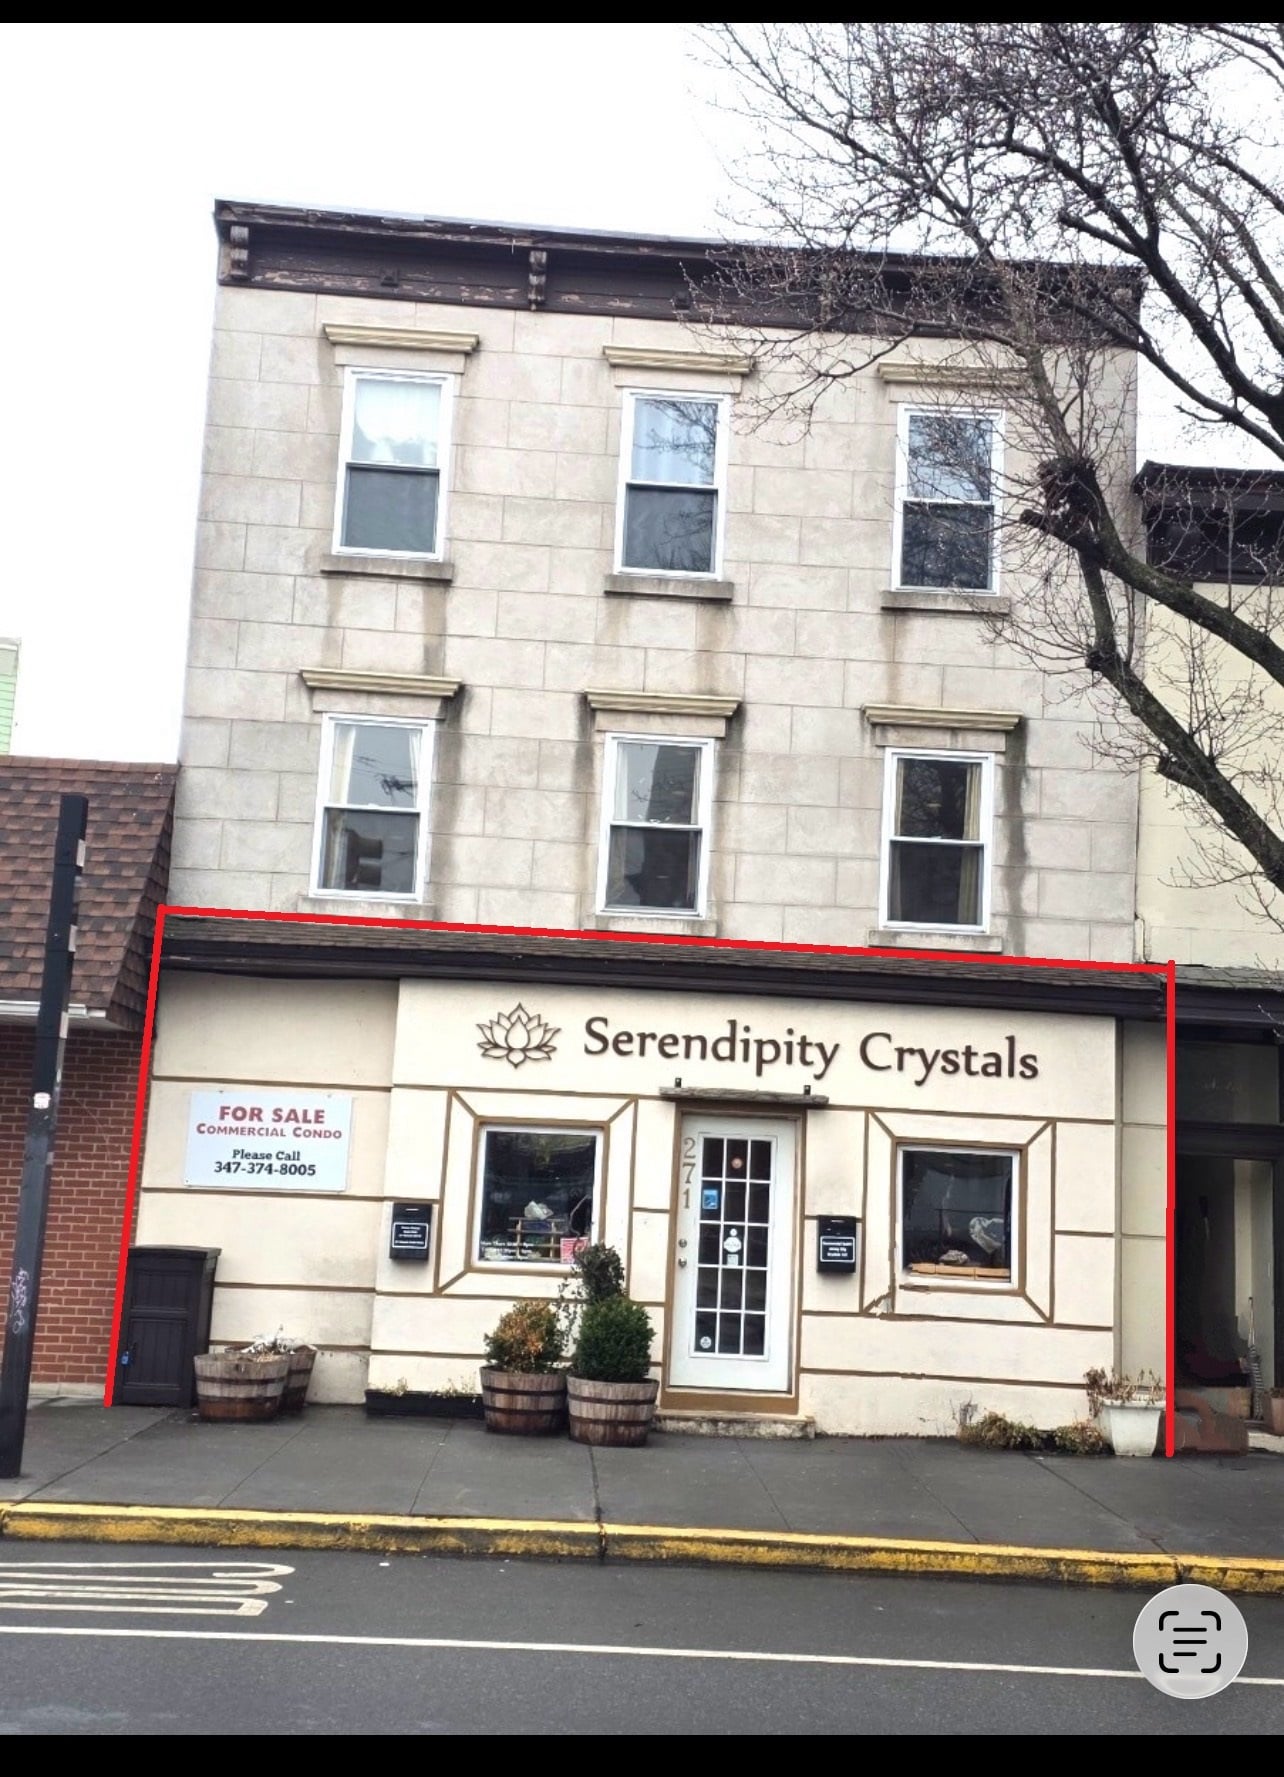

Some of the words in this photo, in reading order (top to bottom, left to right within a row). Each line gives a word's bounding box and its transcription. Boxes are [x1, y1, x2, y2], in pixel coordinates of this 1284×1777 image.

[583, 1016, 841, 1078] Serendipity
[858, 1031, 1040, 1086] Crystals
[218, 1105, 264, 1123] FOR
[271, 1107, 326, 1125] SALE
[196, 1122, 287, 1138] COMMERCIAL
[292, 1126, 343, 1140] CONDO
[232, 1148, 273, 1161] Please
[275, 1150, 301, 1162] Call
[213, 1161, 317, 1177] 347-374-8005
[681, 1136, 697, 1210] 271
